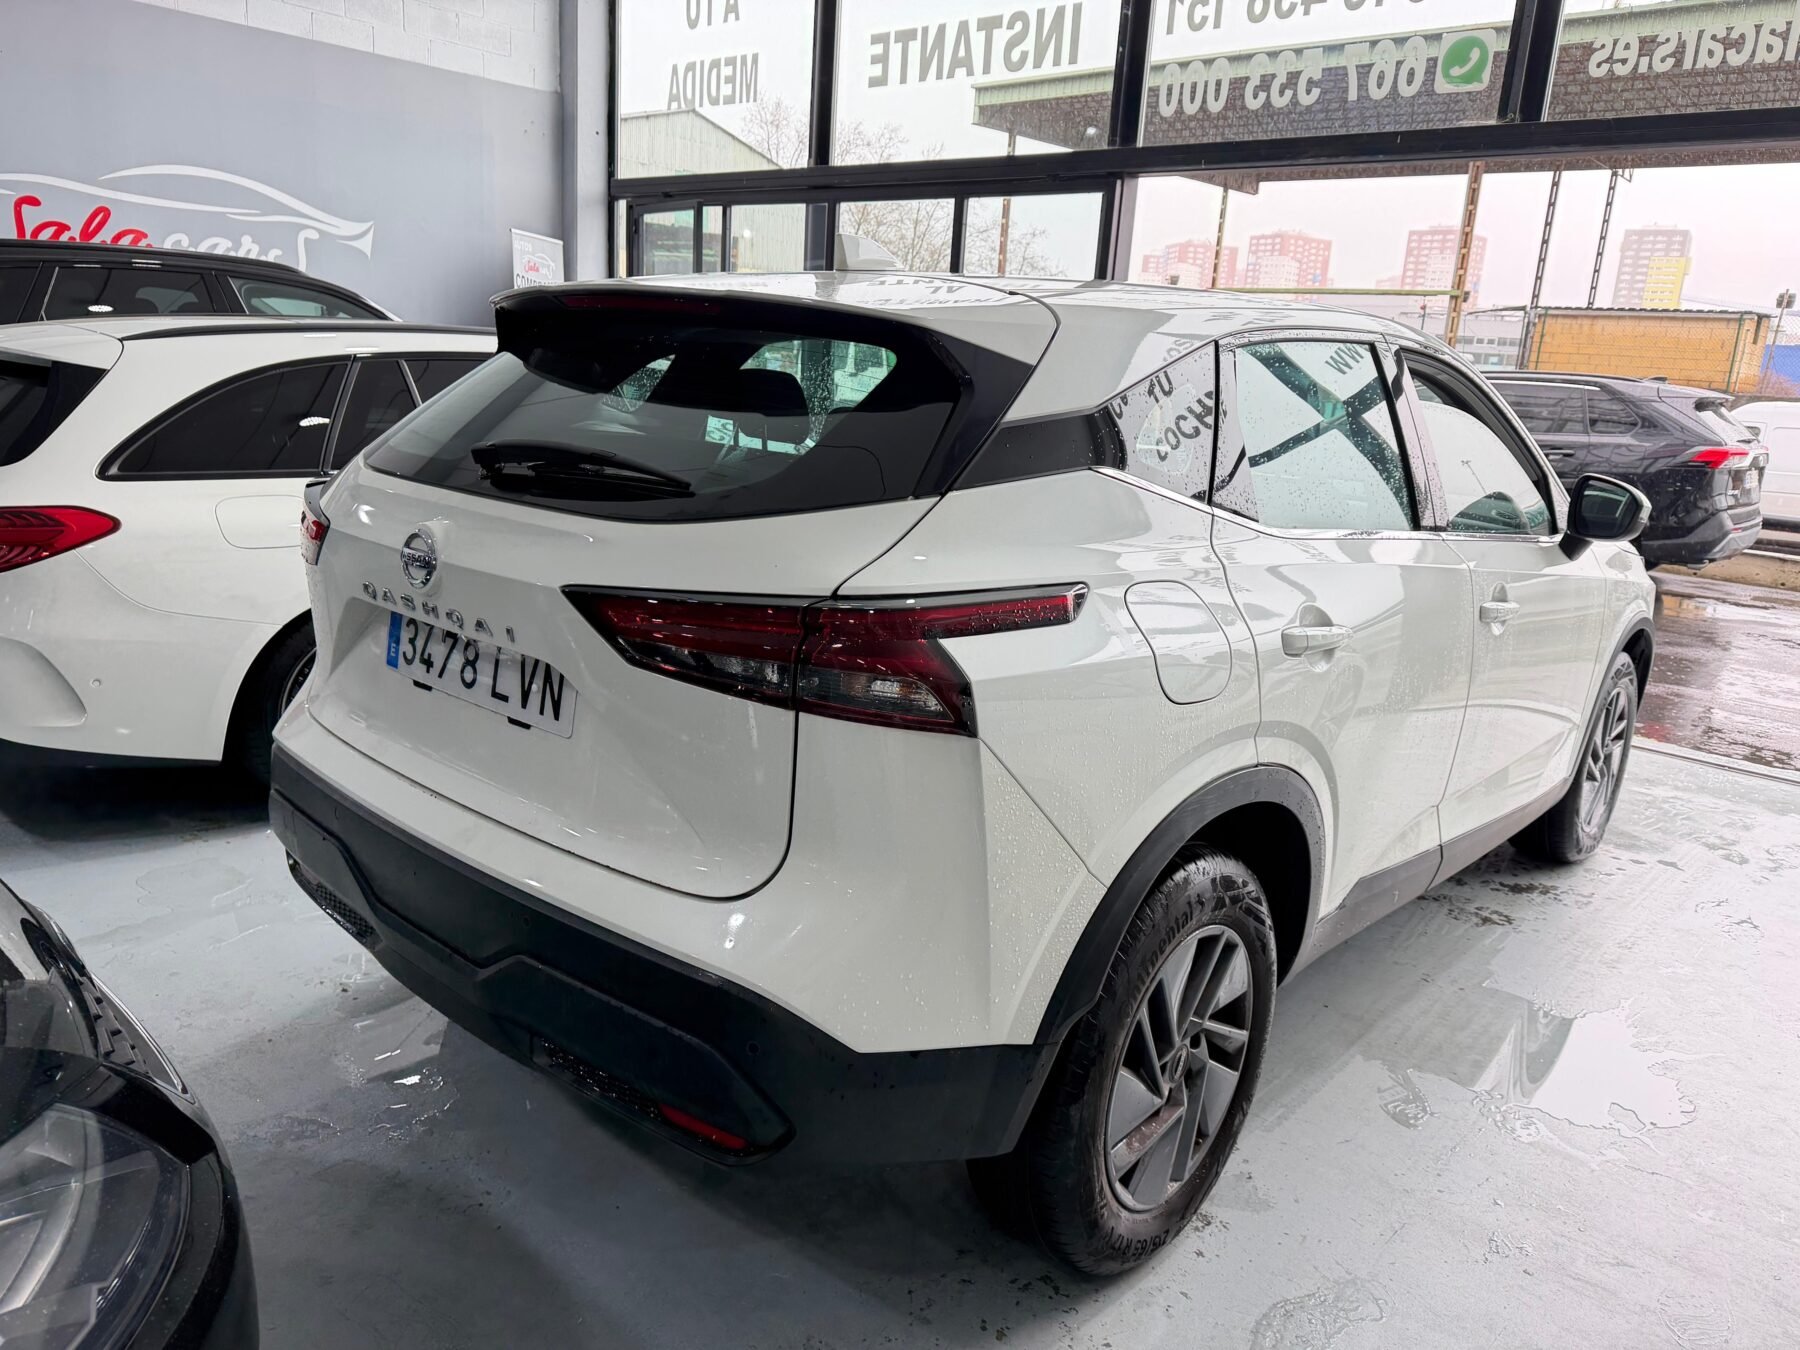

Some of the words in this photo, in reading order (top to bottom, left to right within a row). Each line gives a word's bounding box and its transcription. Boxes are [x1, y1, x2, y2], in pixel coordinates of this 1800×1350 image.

[362, 580, 515, 643] QASHQAI
[390, 643, 397, 657] E
[402, 617, 480, 690] 3478
[491, 645, 565, 722] LVN
